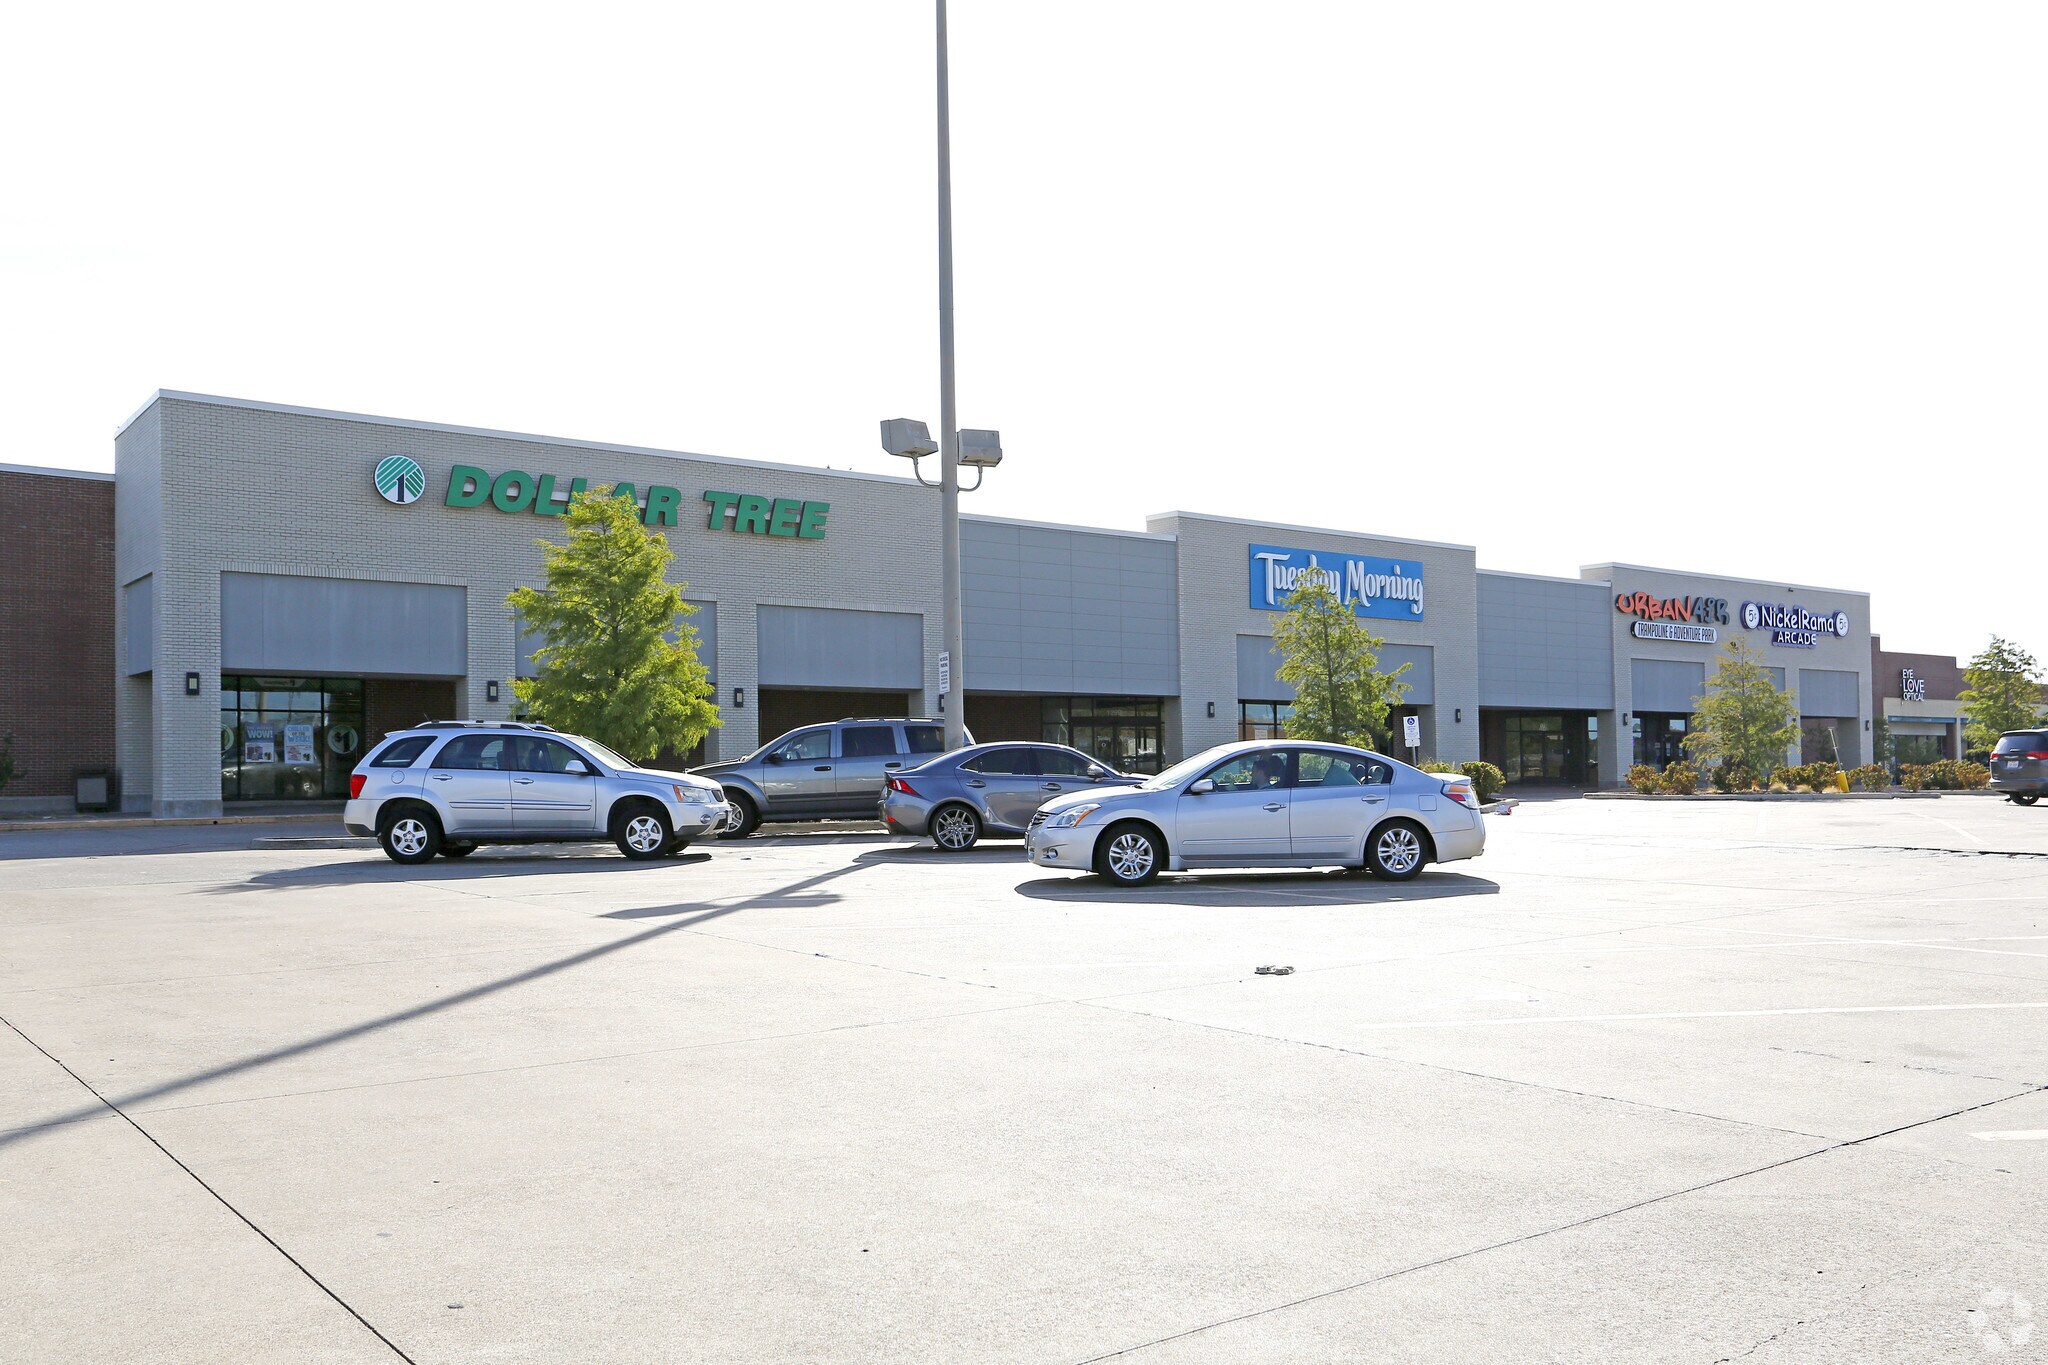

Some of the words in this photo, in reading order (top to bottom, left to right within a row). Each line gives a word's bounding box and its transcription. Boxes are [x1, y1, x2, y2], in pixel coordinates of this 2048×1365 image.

[703, 490, 831, 540] TREE
[1343, 559, 1423, 615] Morning
[1616, 591, 1692, 622] URBAN
[1760, 605, 1835, 633] NickelRama
[1637, 622, 1669, 639] TRAMPOLINE
[1674, 625, 1701, 641] ADVENTURE
[1701, 628, 1715, 642] PARK
[1777, 631, 1817, 645] ARCADE
[1902, 669, 1914, 679] EYE
[1902, 679, 1925, 692] LOVE
[1903, 692, 1925, 701] OPTICAL
[247, 730, 273, 739] WOW!
